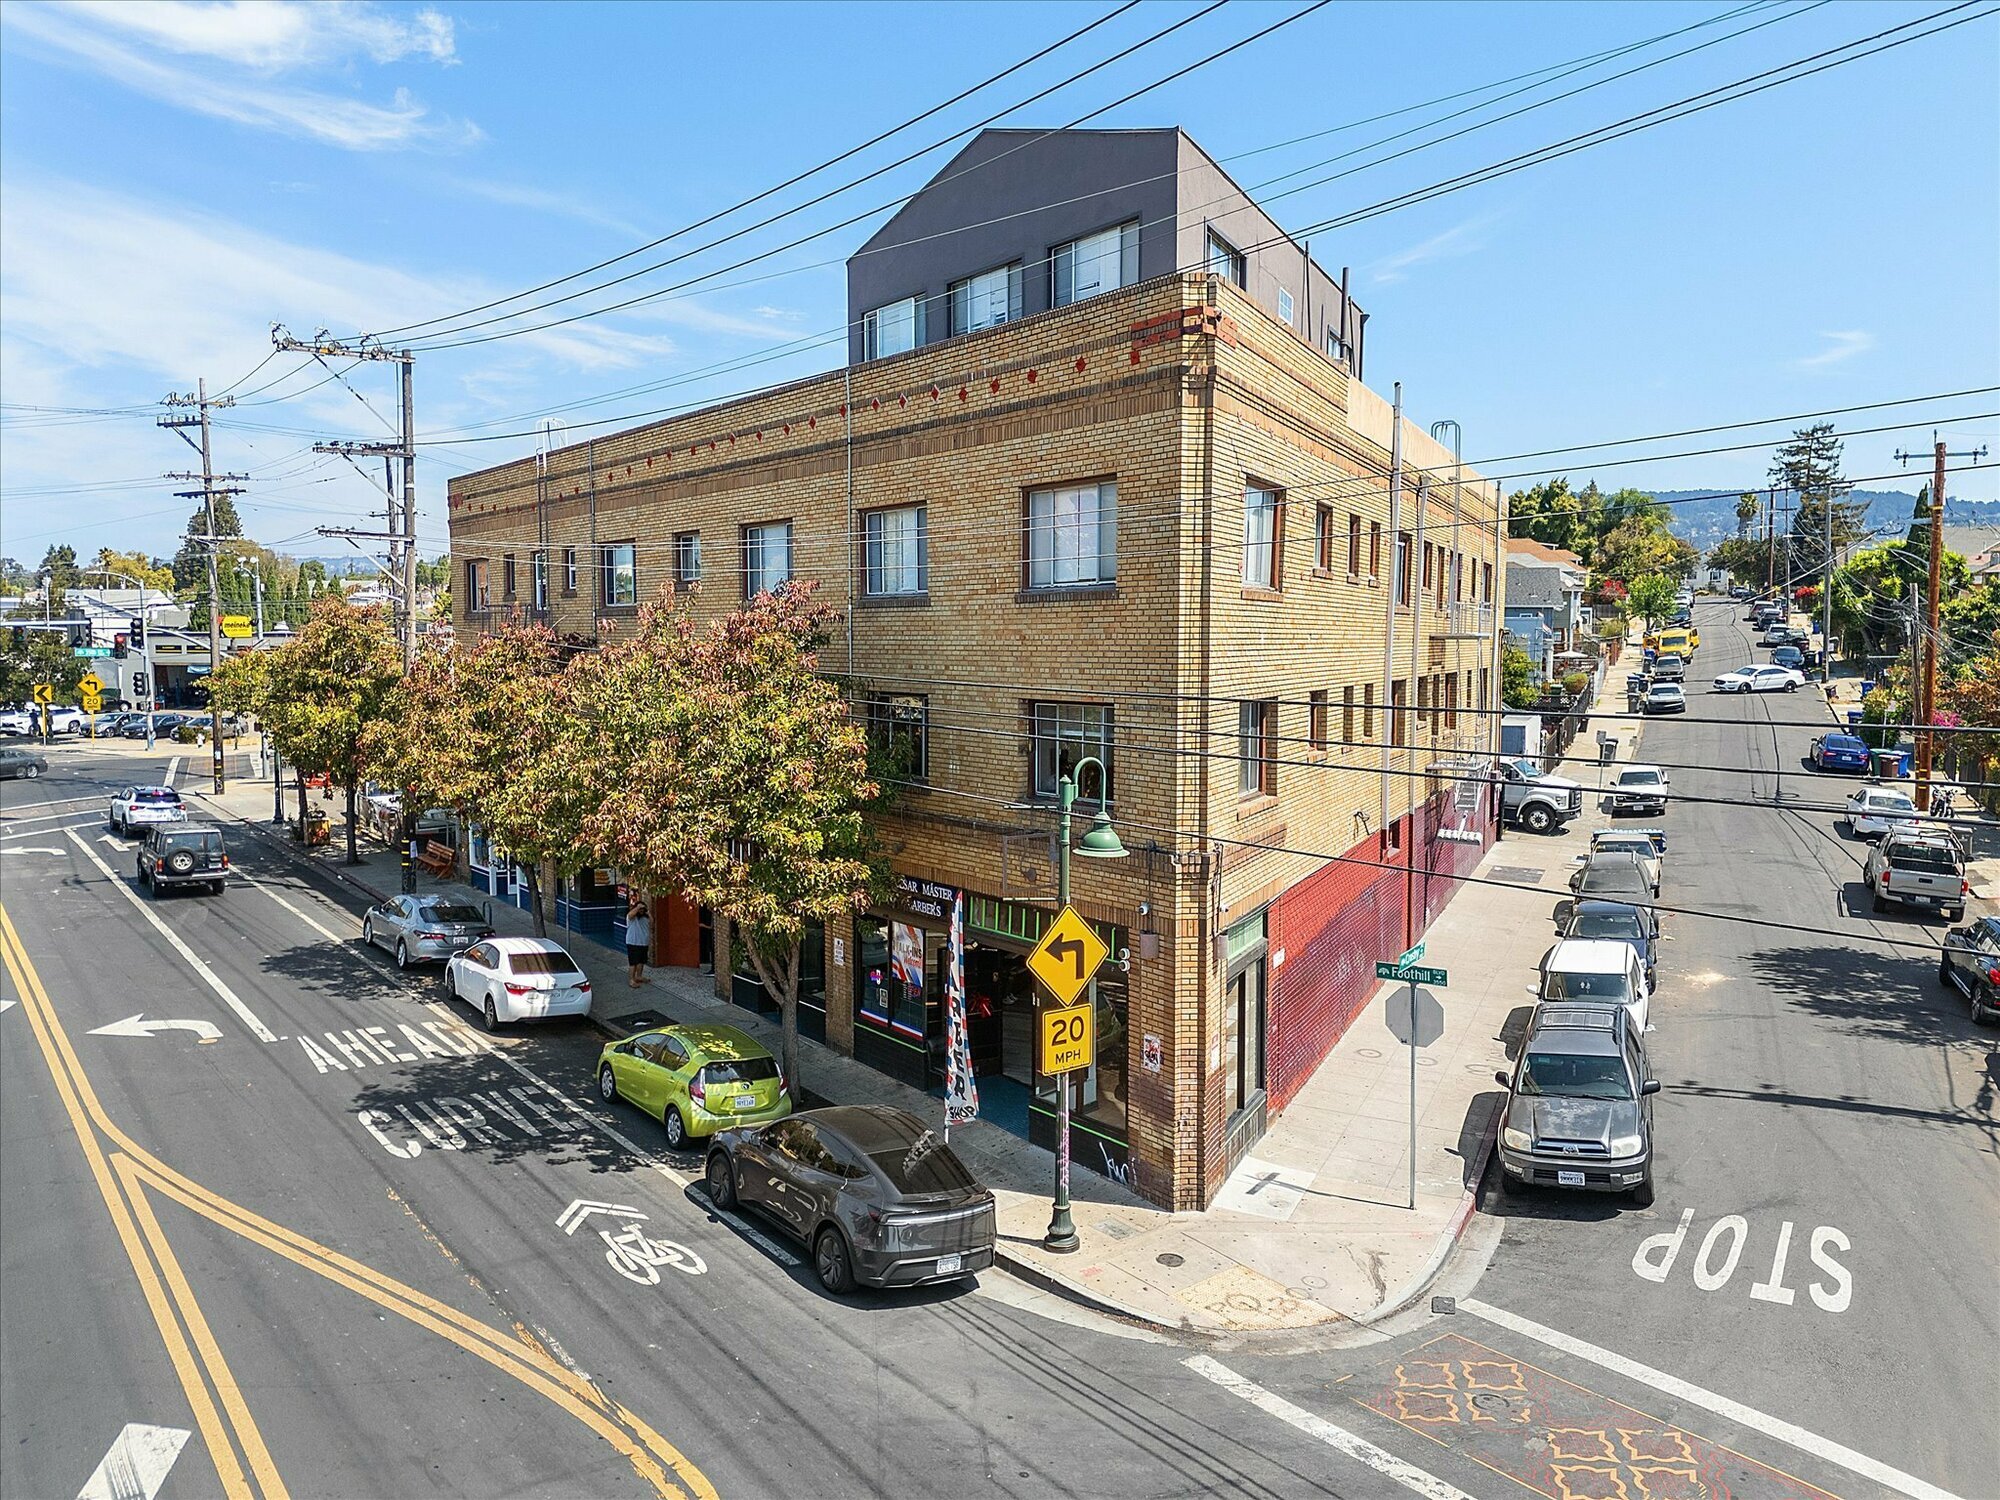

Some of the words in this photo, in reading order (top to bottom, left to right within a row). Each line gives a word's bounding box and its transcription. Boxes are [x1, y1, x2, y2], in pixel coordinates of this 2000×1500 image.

[897, 879, 918, 893] SAR
[922, 882, 953, 902] MÁSTER
[1391, 967, 1431, 982] Foothill
[1051, 1015, 1085, 1047] 20
[297, 1021, 479, 1073] AHEAD
[1055, 1049, 1081, 1065] MPH
[358, 1085, 591, 1159] CURVE
[949, 1105, 976, 1120] SHOP
[1632, 1208, 1853, 1313] STOP
